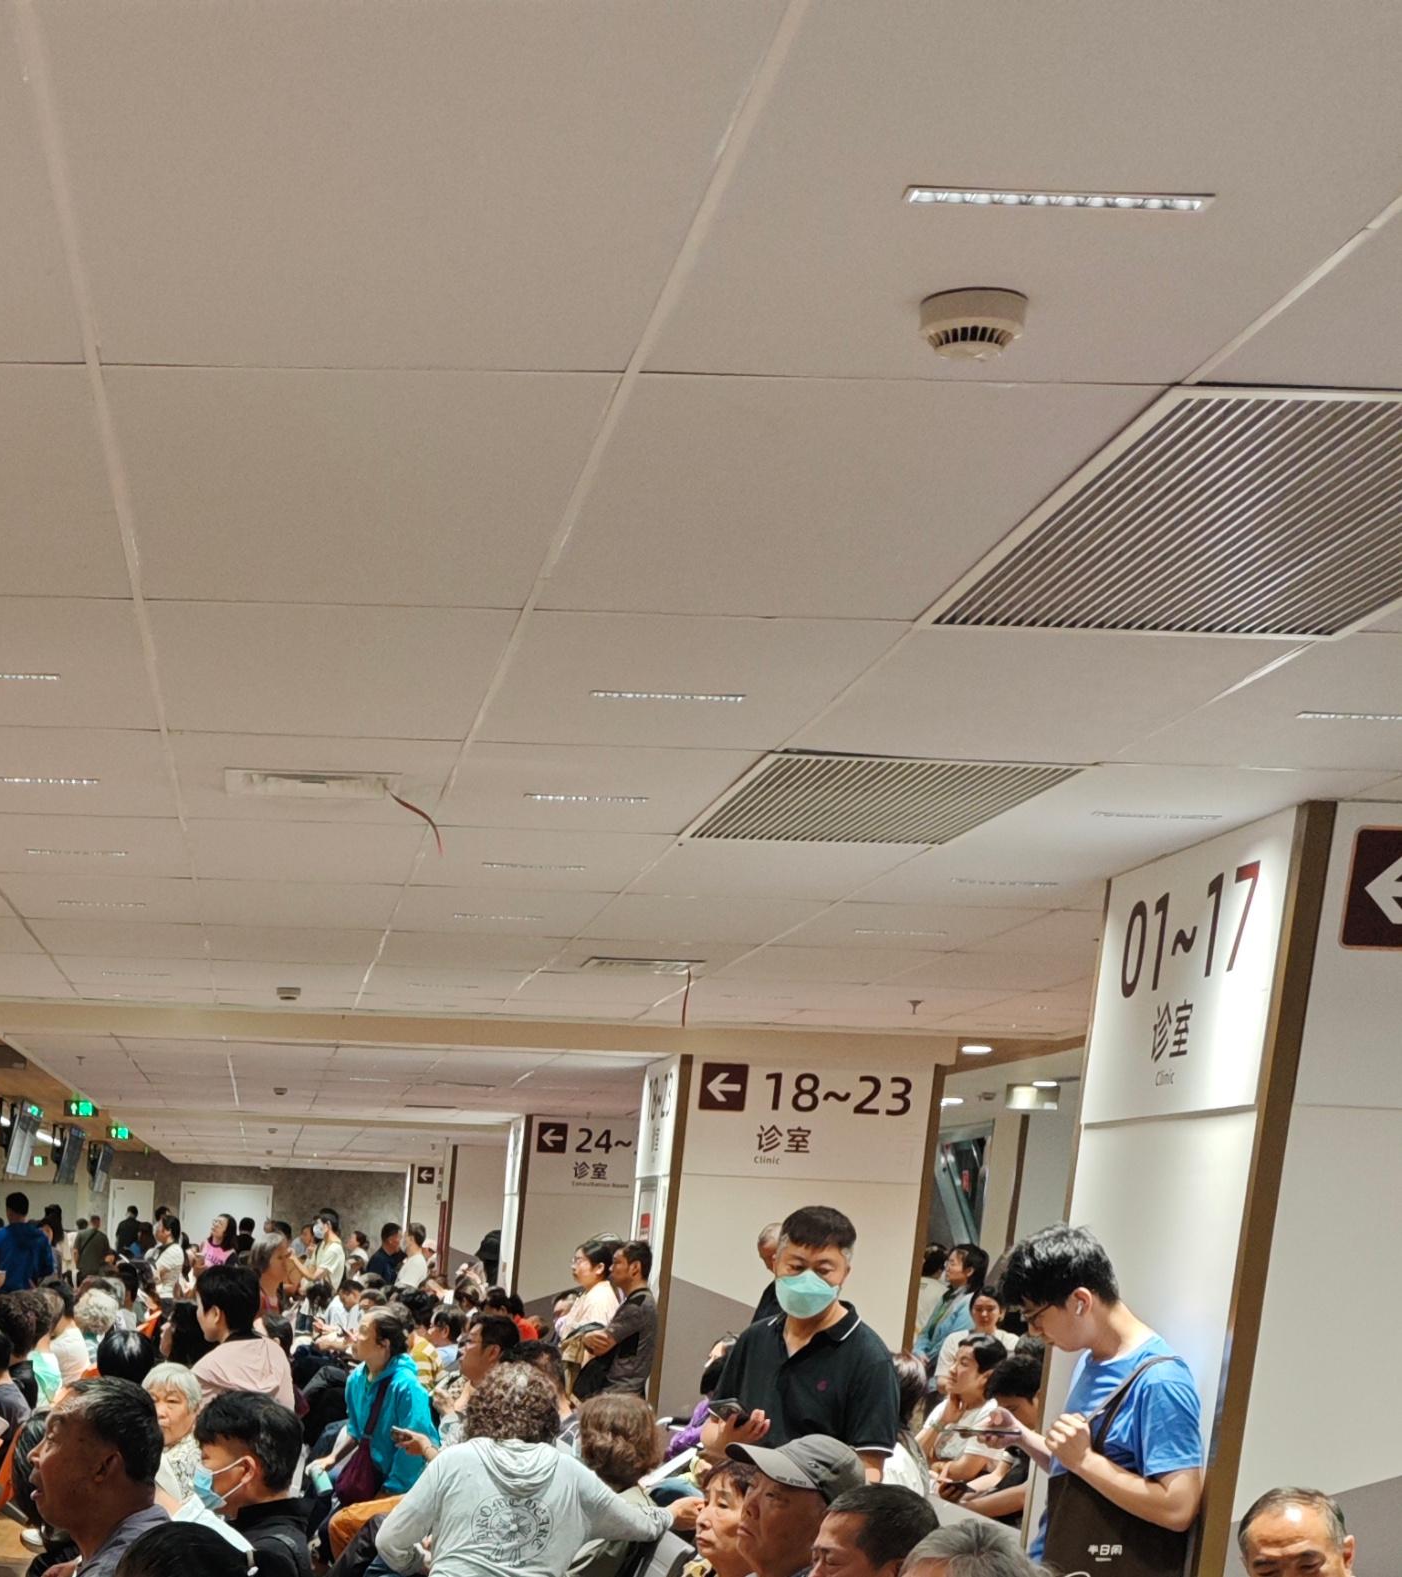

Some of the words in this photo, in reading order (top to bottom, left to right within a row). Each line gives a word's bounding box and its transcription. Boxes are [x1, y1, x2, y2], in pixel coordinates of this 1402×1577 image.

[1120, 860, 1262, 999] 01~17
[1151, 999, 1194, 1063] 诊室
[1155, 1068, 1175, 1087] Clinic
[764, 1071, 913, 1117] 18~23
[575, 1127, 637, 1155] 24~
[756, 1124, 812, 1154] 诊室
[573, 1161, 608, 1180] 诊室
[753, 1155, 781, 1165] Clinic
